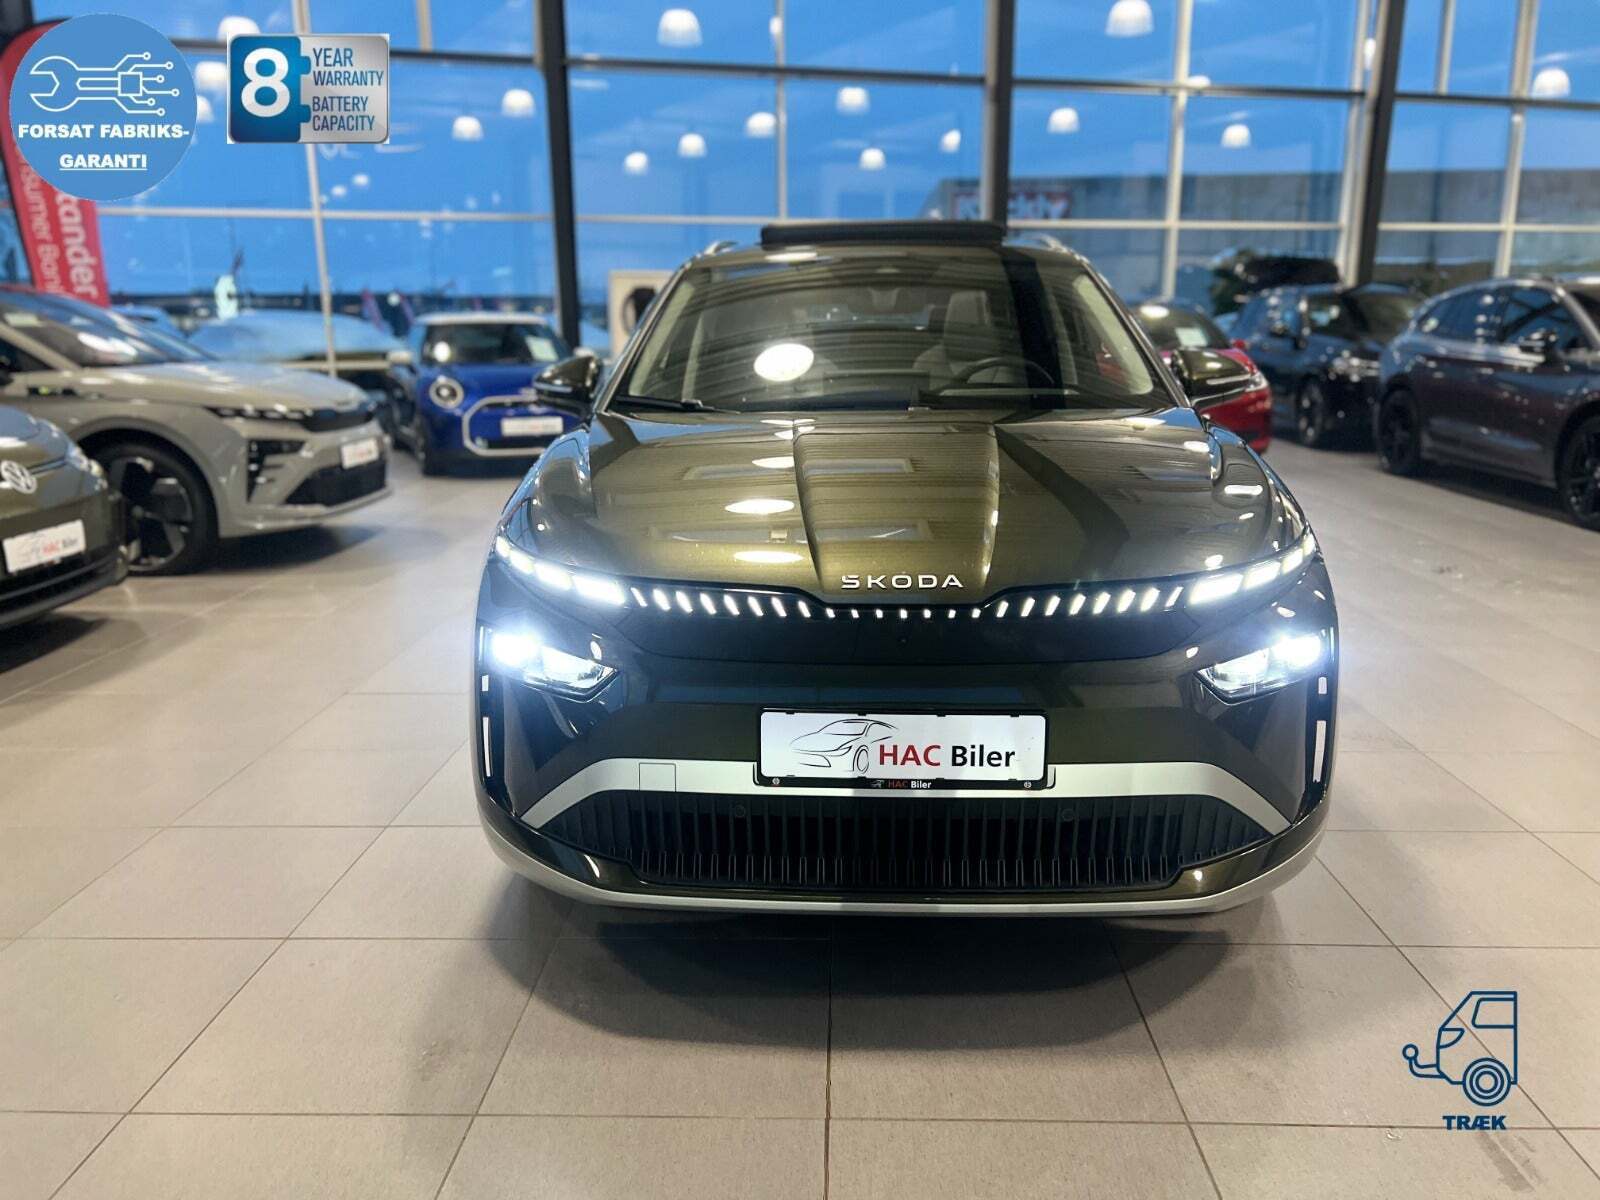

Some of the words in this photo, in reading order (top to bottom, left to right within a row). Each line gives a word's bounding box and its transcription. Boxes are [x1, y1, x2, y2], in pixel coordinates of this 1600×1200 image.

[879, 744, 941, 767] HAC
[951, 744, 1016, 767] Biler
[888, 780, 909, 789] HAC
[910, 780, 932, 789] Biler
